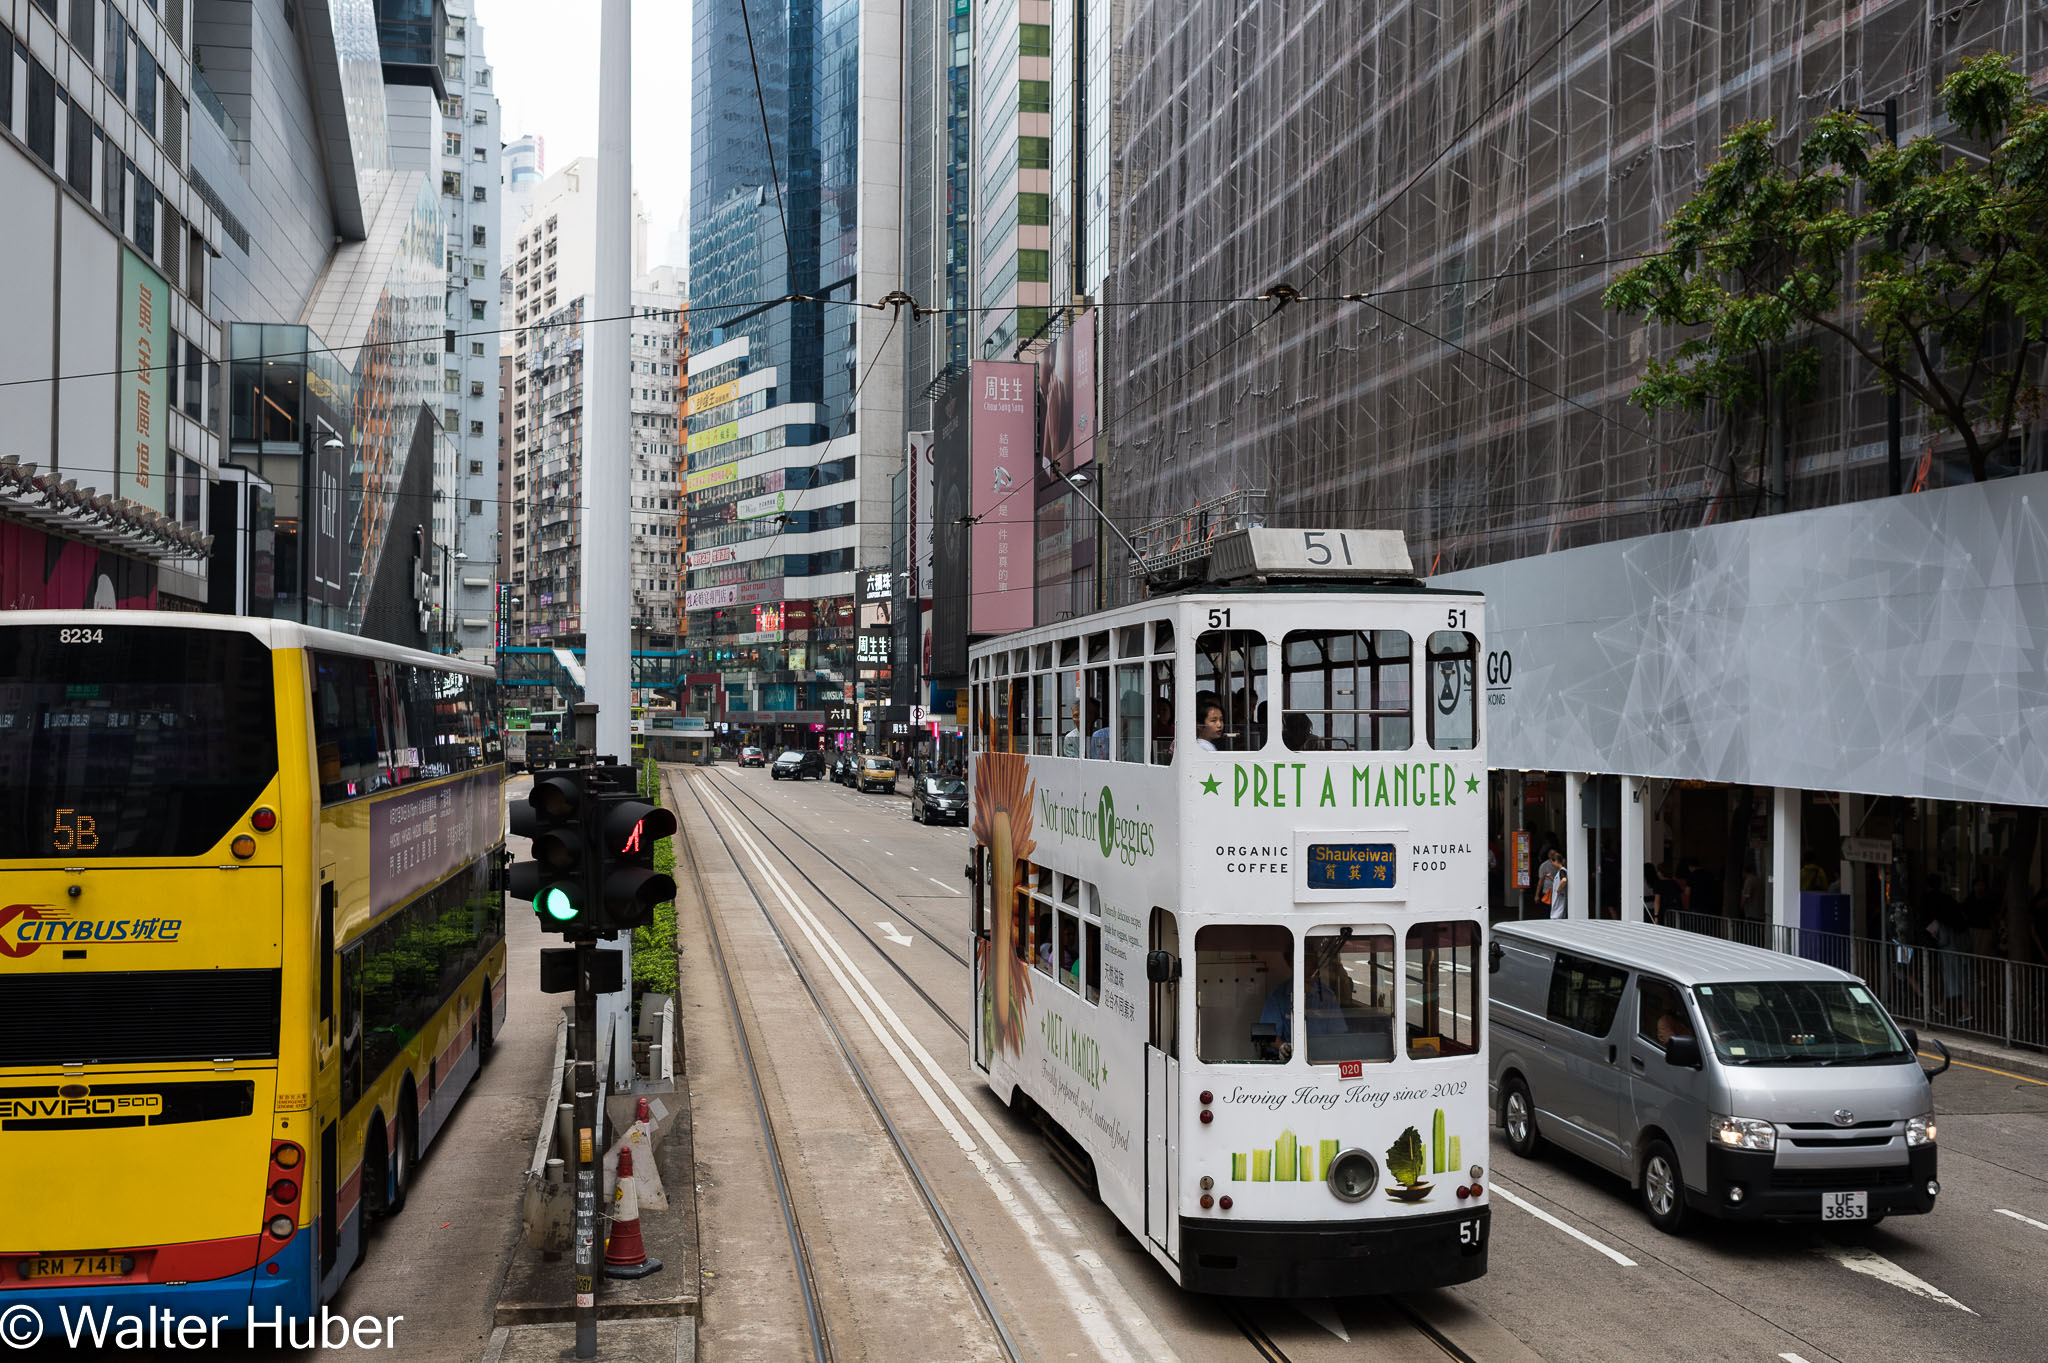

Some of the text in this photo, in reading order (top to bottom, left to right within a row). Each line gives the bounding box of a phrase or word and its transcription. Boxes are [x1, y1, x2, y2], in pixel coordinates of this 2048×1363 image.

[984, 376, 1023, 401] 周生生
[321, 469, 337, 539] GAP
[1303, 531, 1353, 566] 51
[866, 573, 892, 592] 六福珠
[1208, 608, 1231, 628] 51
[1447, 609, 1467, 628] 51
[60, 628, 104, 644] 8234
[857, 635, 888, 655] 周生生
[1464, 650, 1512, 687] SGO
[1234, 763, 1457, 807] PRET A MANGER
[1041, 788, 1058, 831] Not
[1060, 791, 1079, 845] just
[1081, 791, 1097, 841] for
[53, 808, 99, 850] 5B
[1215, 846, 1289, 857] ORGANIC
[1412, 844, 1472, 855] NATURAL
[1227, 863, 1288, 874] COFFEE
[1325, 864, 1387, 881] 筲箕灣
[1412, 862, 1447, 872] FOOD
[17, 920, 131, 942] CITYBUS
[130, 917, 183, 940] 城巴
[1046, 1007, 1100, 1092] PRET A MANGER
[1341, 1064, 1360, 1076] 020
[1223, 1081, 1468, 1111] Serving Hong Kong since 2002
[1834, 1193, 1855, 1206] UF
[1825, 1205, 1865, 1219] 3853
[1459, 1219, 1481, 1244] 51
[36, 1256, 116, 1275] RM 7141
